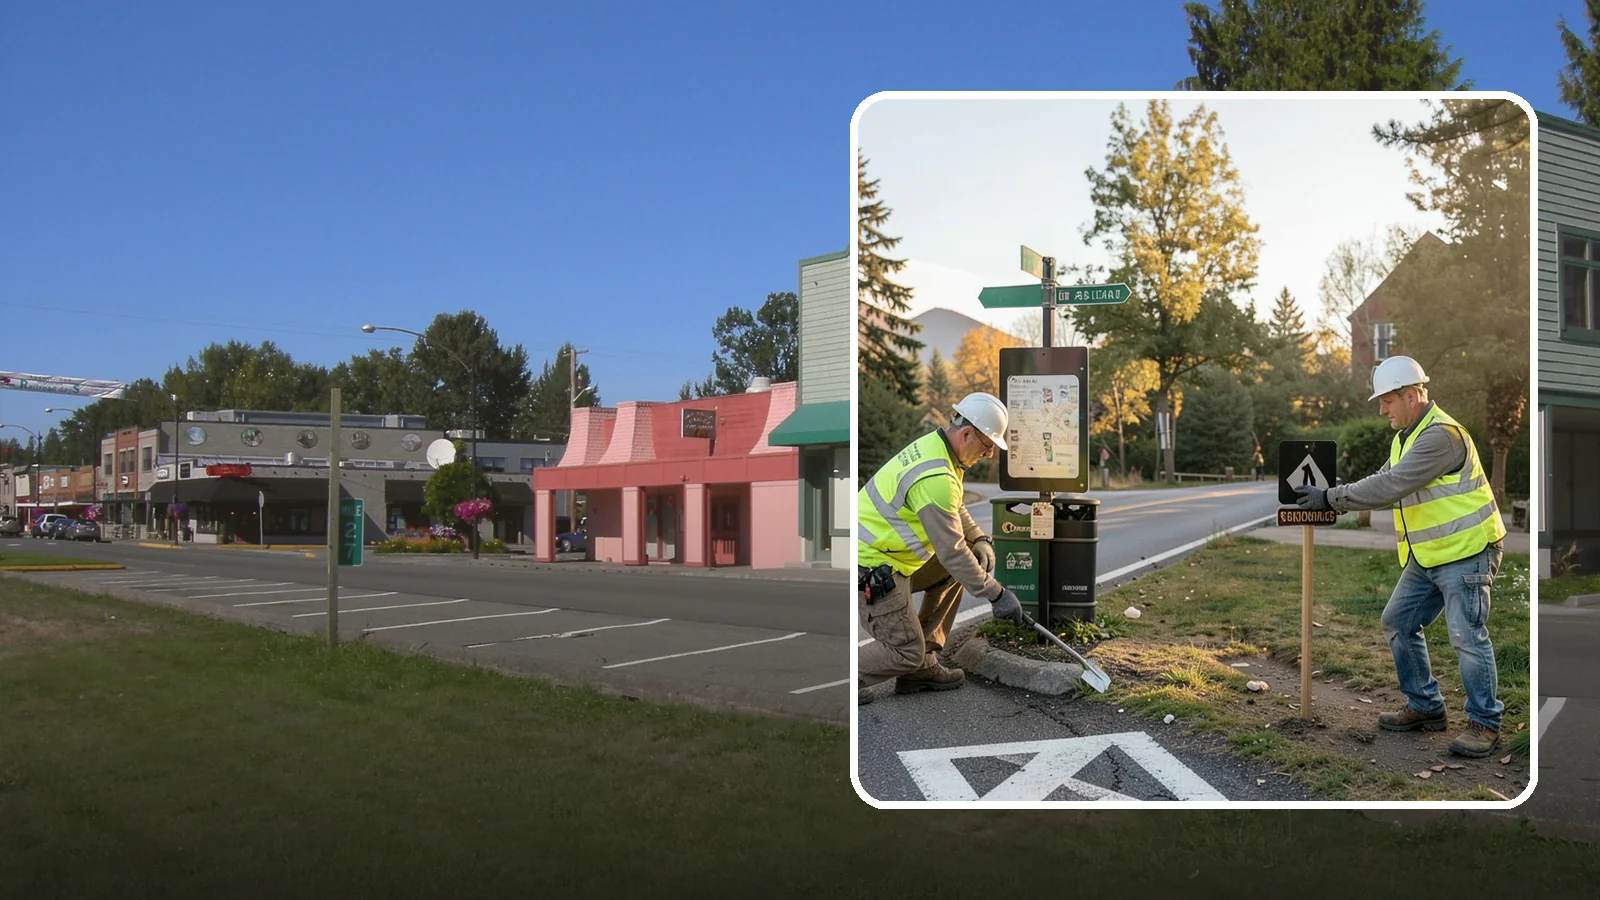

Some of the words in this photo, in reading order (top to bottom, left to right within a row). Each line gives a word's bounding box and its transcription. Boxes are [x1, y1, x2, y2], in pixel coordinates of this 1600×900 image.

[341, 505, 361, 517] MILE
[344, 522, 356, 539] 2
[344, 543, 356, 560] 7
